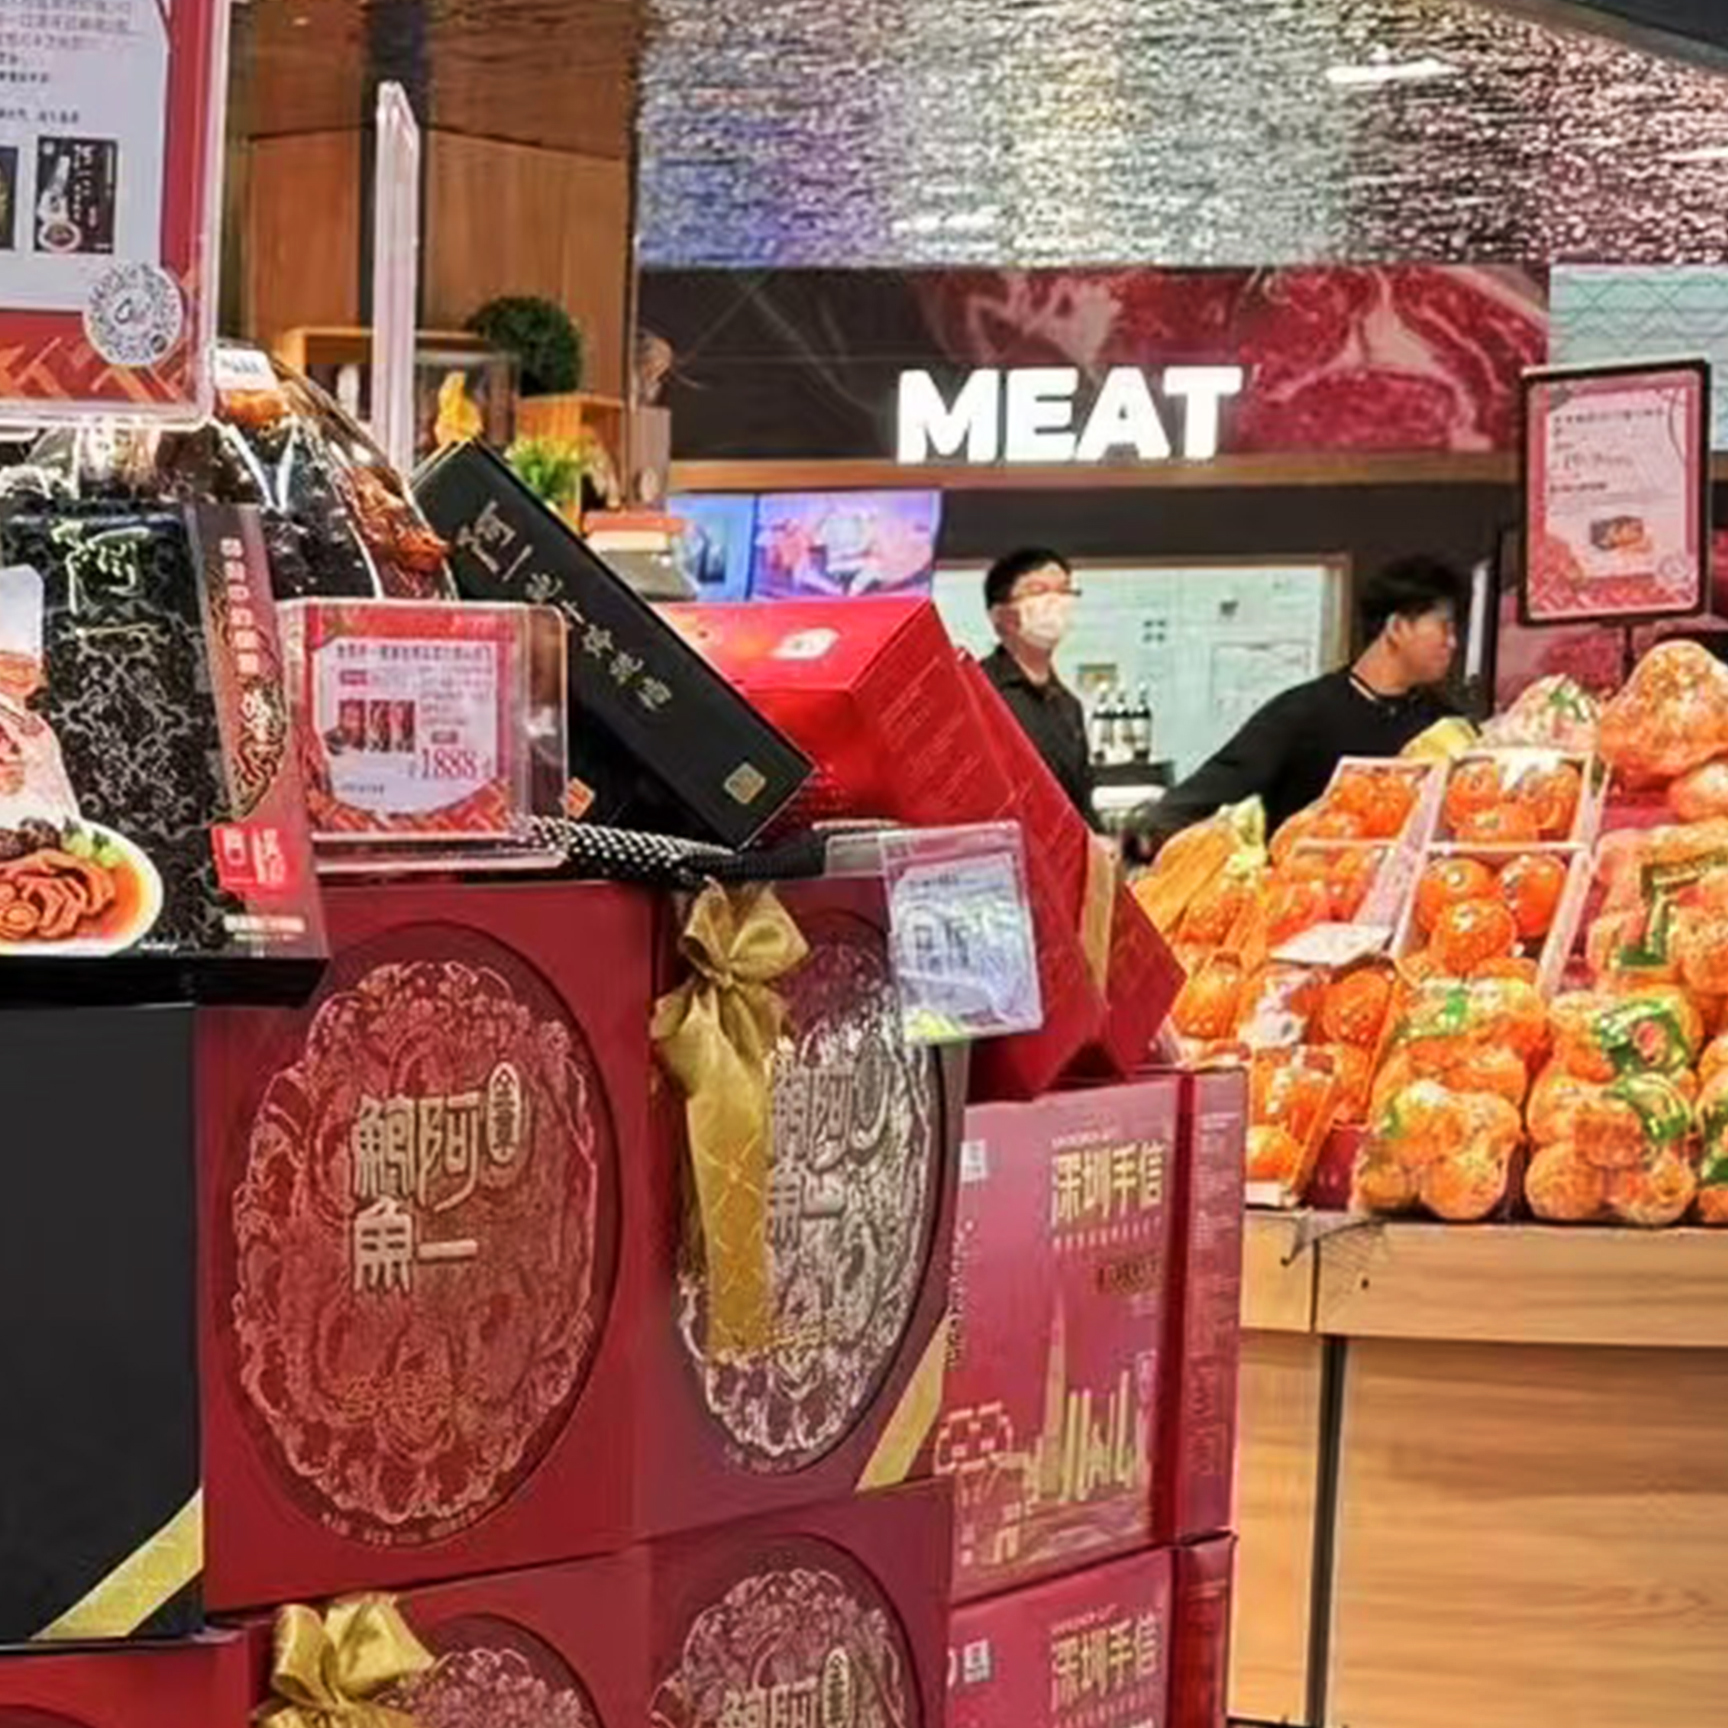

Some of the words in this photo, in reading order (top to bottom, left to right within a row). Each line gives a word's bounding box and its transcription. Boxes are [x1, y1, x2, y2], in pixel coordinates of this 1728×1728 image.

[897, 367, 1242, 465] MEAT
[1050, 1139, 1164, 1229] 深圳手信
[1050, 1614, 1158, 1710] 深圳手信
